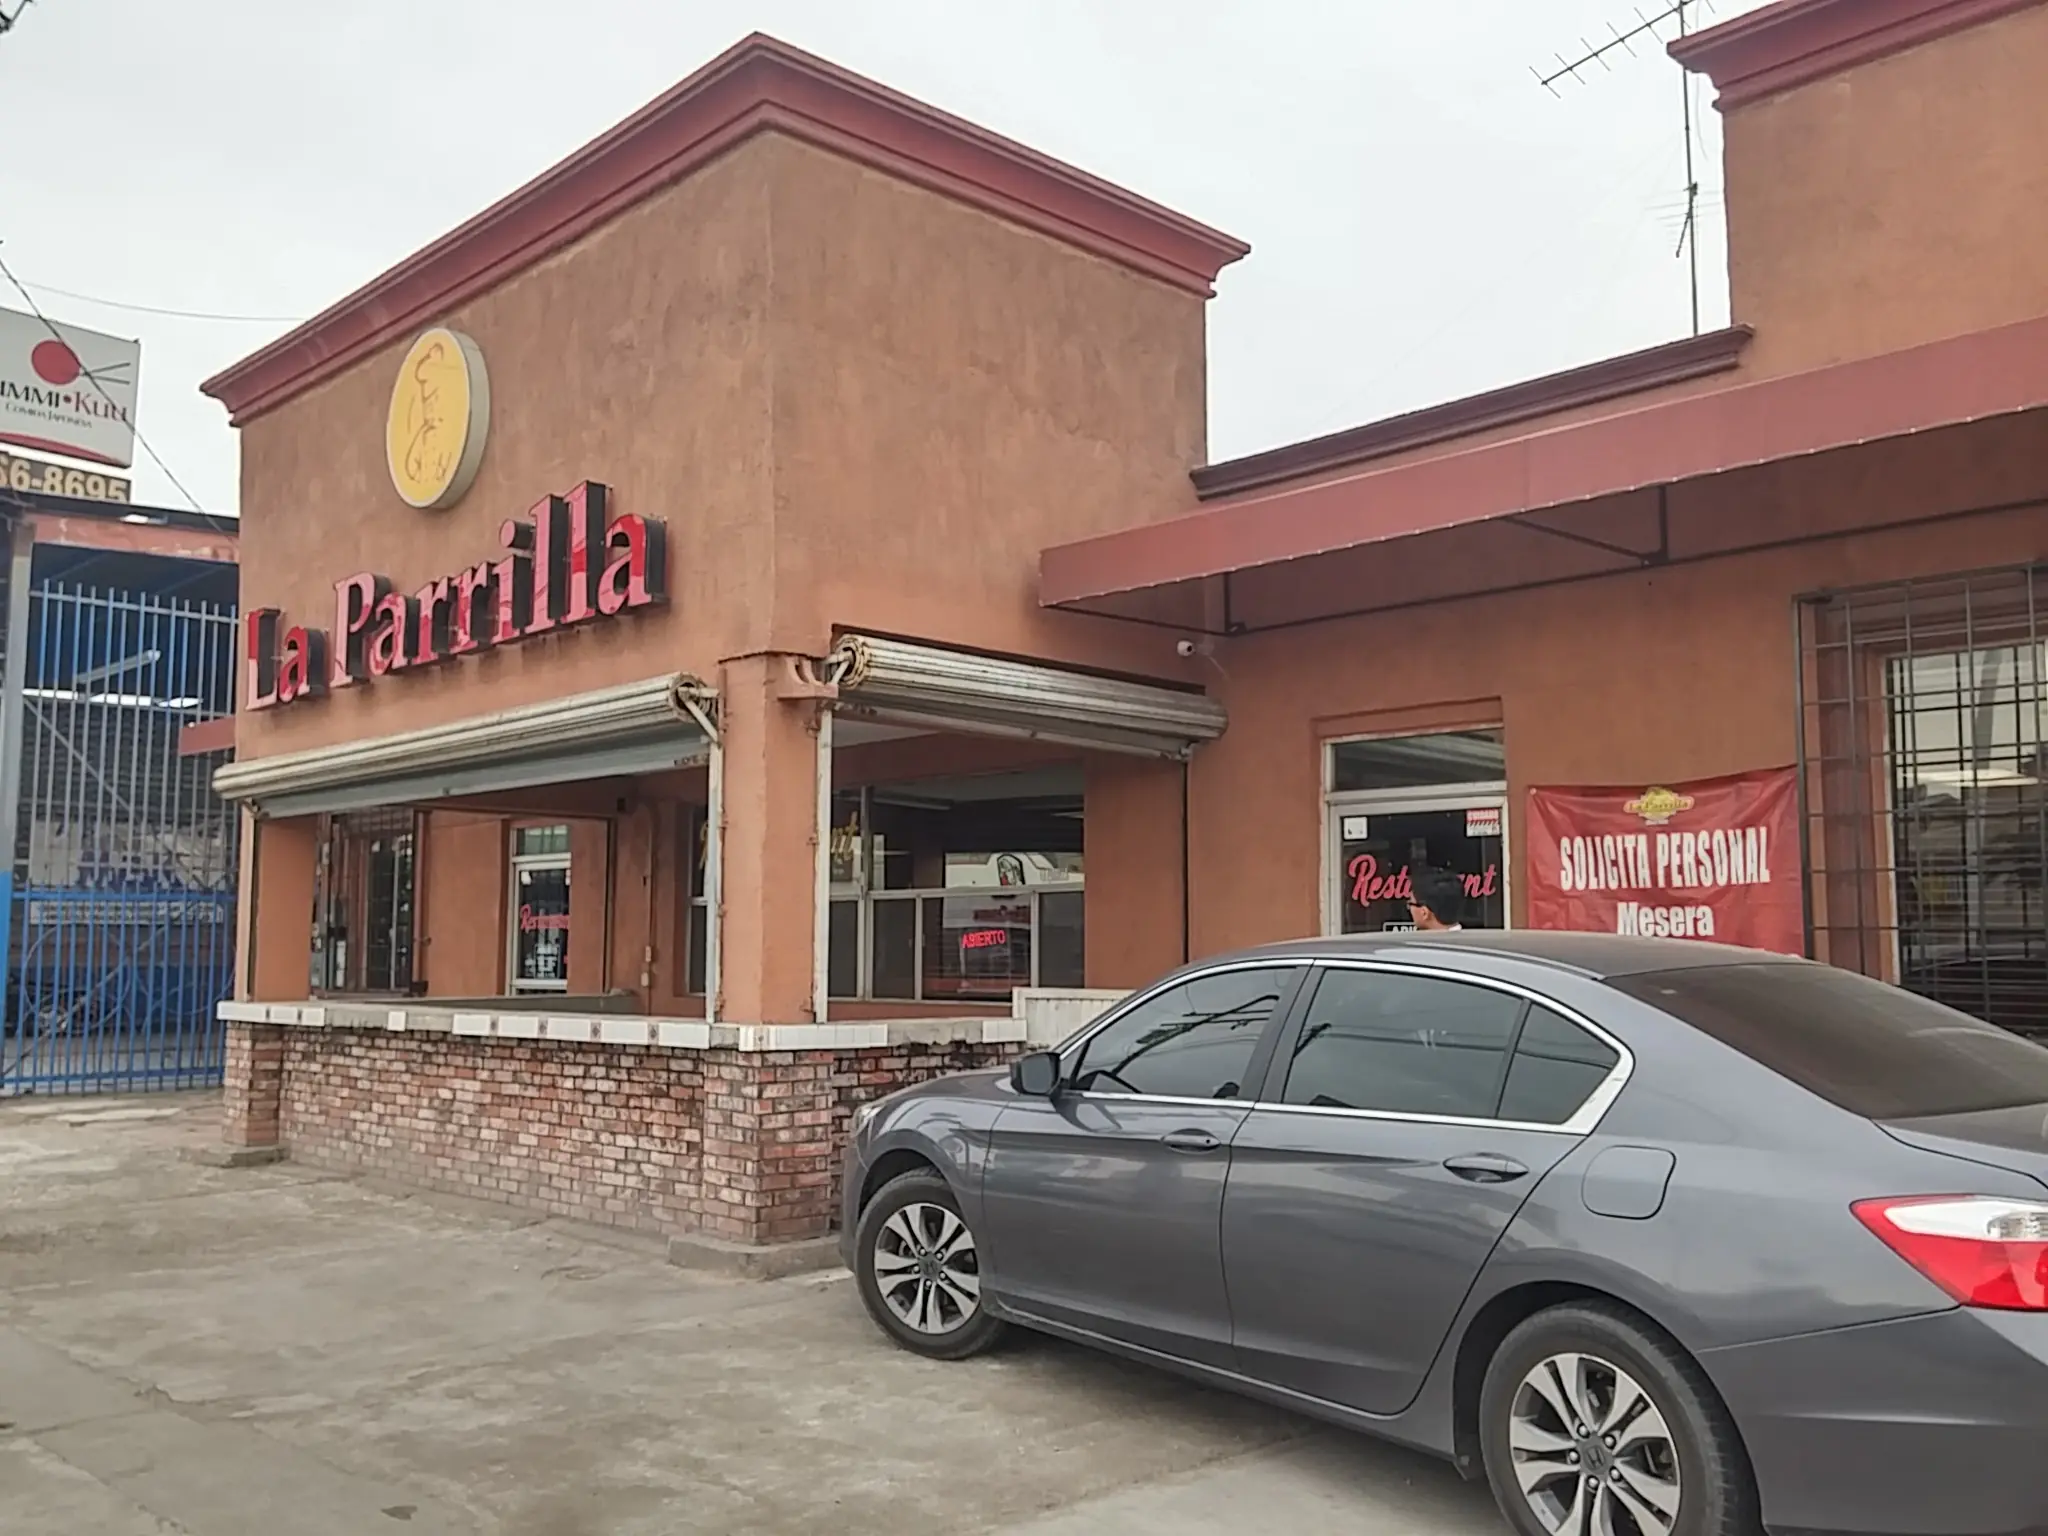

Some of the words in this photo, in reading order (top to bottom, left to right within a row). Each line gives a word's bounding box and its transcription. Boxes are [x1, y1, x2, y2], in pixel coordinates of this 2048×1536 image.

[244, 608, 316, 711] La
[329, 480, 658, 688] Parrilla
[1349, 854, 1496, 907] Restnt
[1560, 832, 1652, 891] SOLICITA
[1656, 826, 1771, 888] PERSONAL
[962, 929, 1006, 949] ABIERTO
[1617, 902, 1715, 936] Mesera
